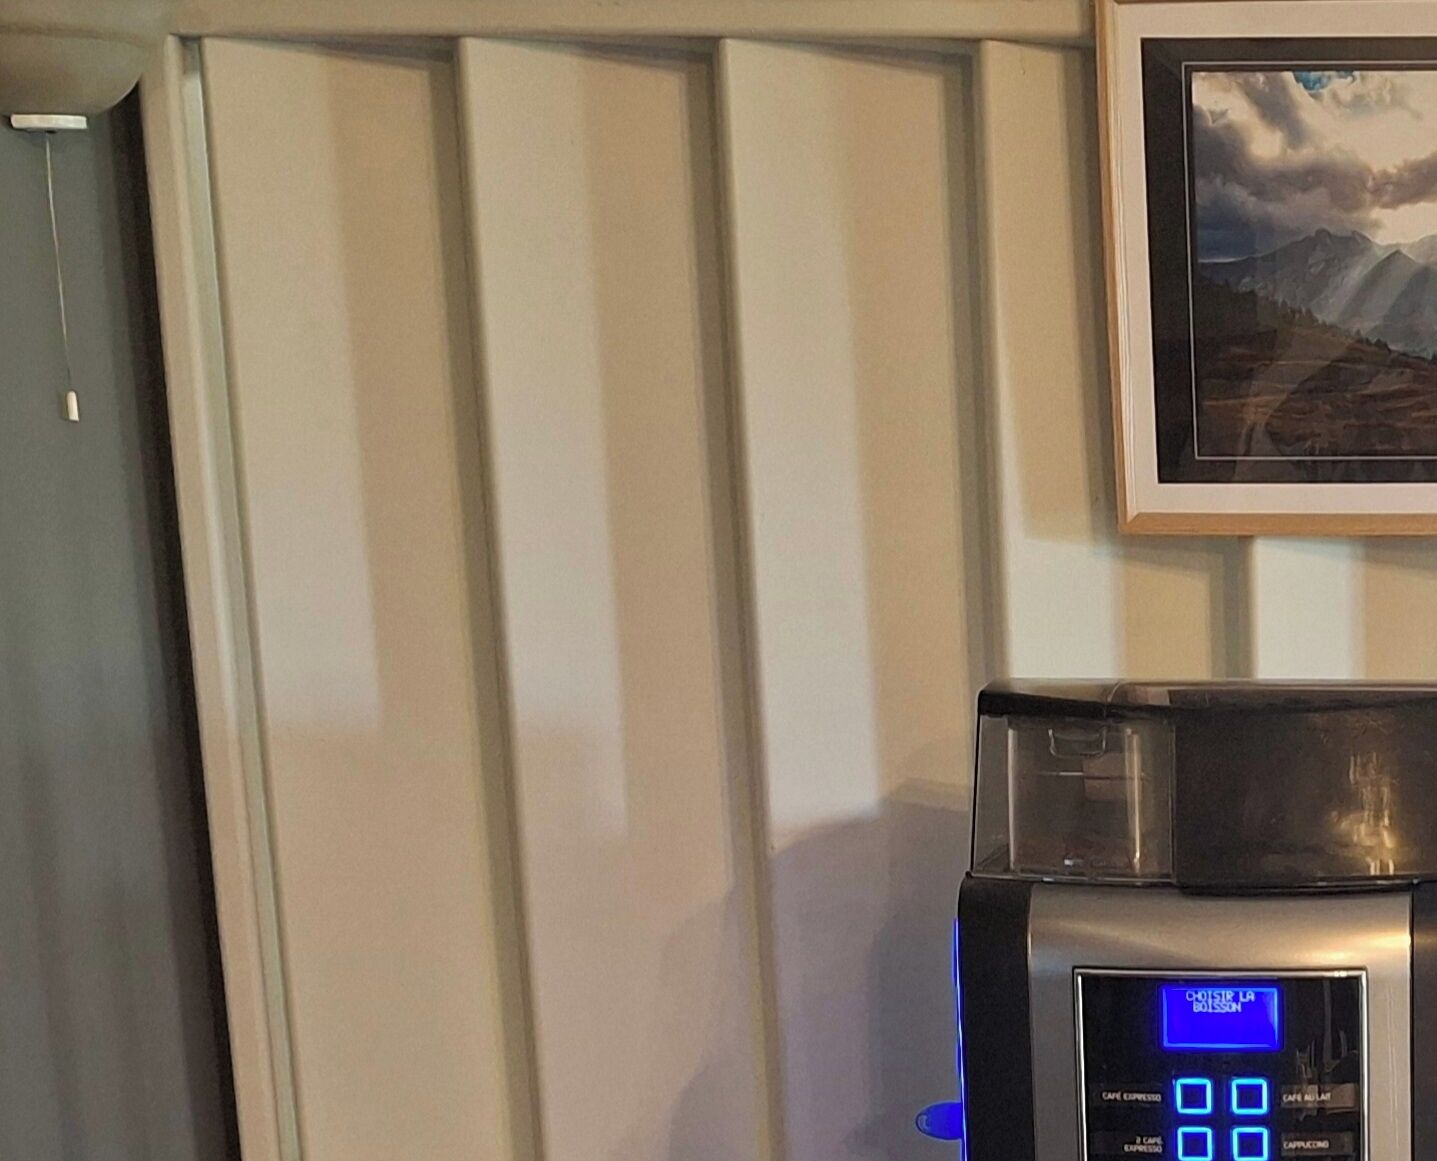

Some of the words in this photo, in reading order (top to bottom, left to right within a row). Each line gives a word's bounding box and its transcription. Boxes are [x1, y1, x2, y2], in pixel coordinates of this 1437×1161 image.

[1185, 990, 1235, 1002] CHOISIR
[1239, 991, 1256, 1002] LA
[1192, 1001, 1242, 1013] BOISSON
